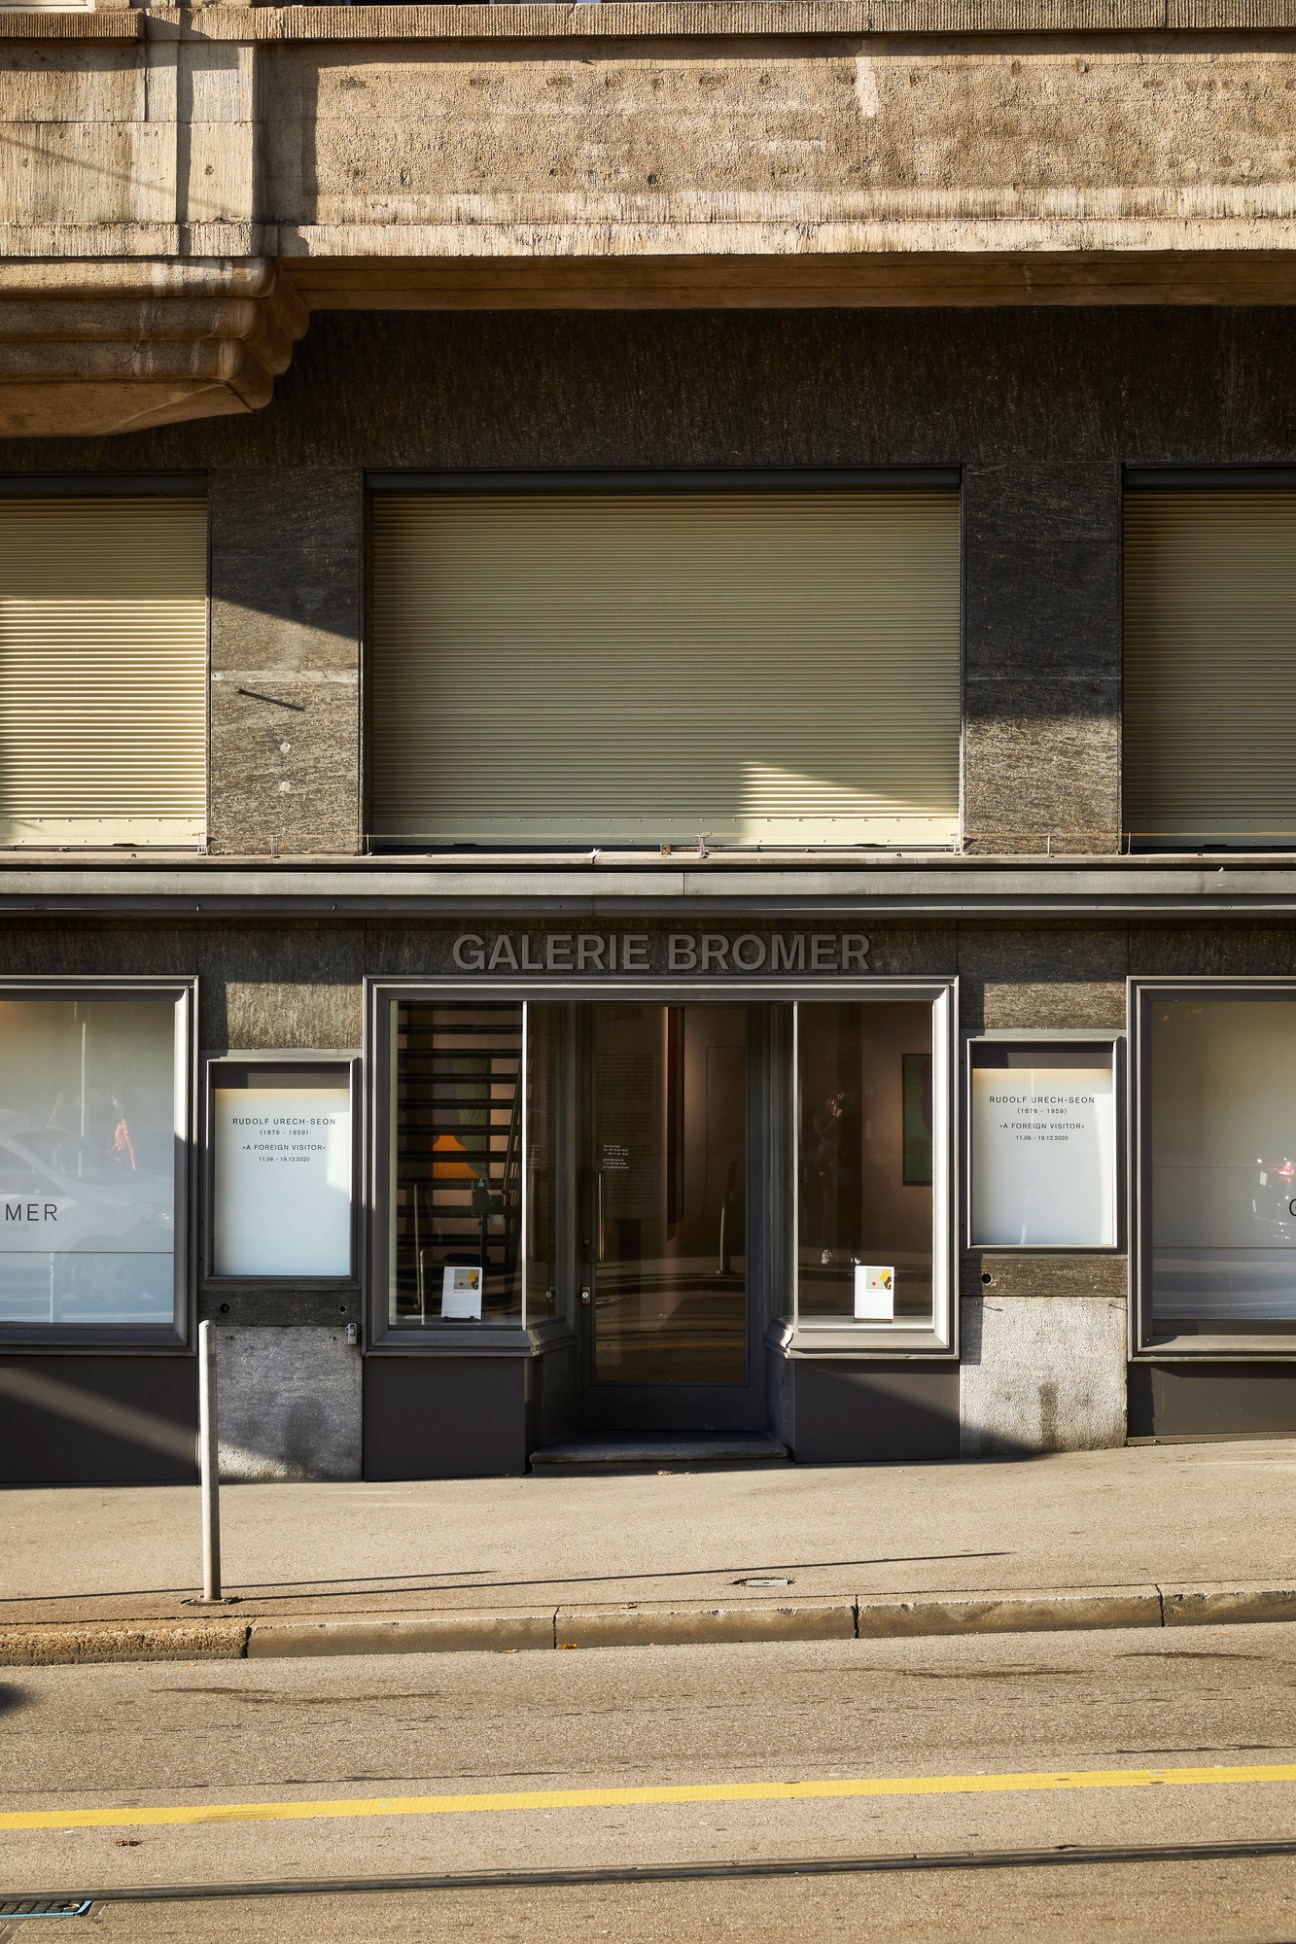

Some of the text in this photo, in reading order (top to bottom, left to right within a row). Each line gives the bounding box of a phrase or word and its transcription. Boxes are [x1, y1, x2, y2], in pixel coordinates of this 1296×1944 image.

[452, 934, 871, 970] GALERIE BROMER
[989, 1096, 1095, 1104] RUDOLF URECH-SEON
[6, 1203, 58, 1221] MER
